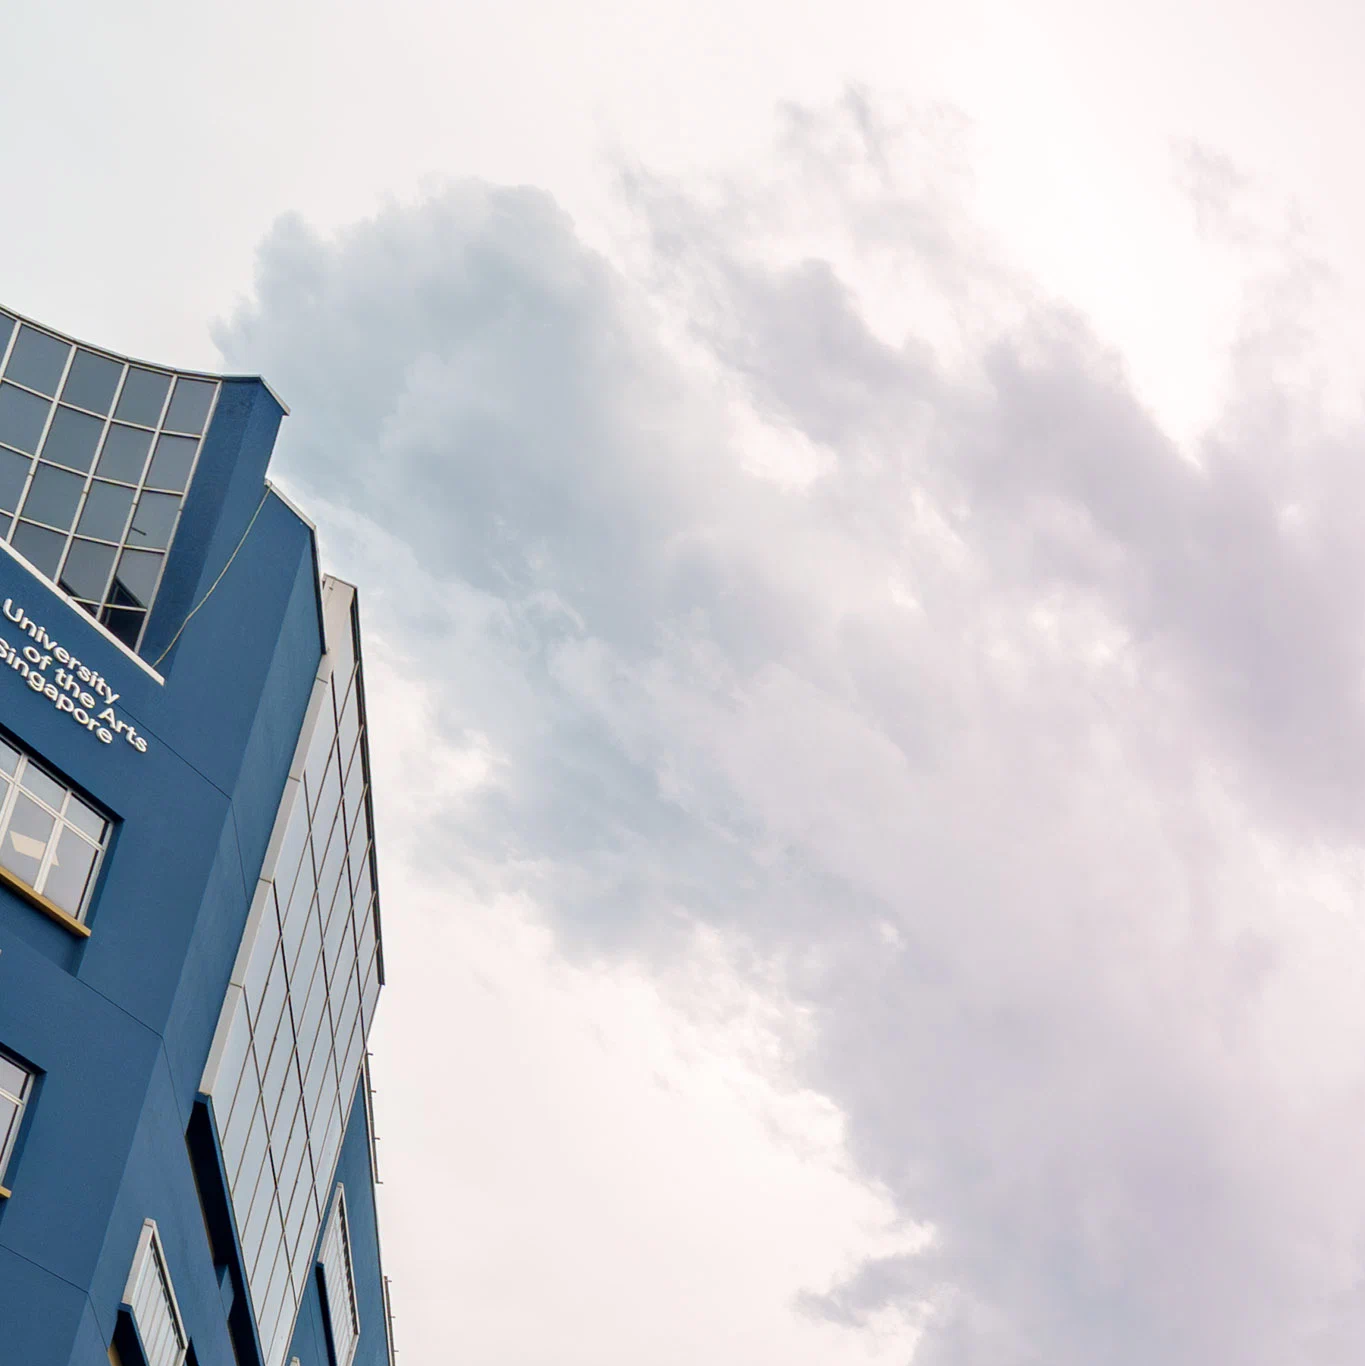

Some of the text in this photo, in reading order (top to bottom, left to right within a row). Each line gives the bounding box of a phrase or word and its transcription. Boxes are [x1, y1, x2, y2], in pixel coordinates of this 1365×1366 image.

[0, 637, 113, 744] Singapore
[3, 598, 120, 705] University
[54, 668, 96, 709] the
[97, 707, 148, 753] Arts
